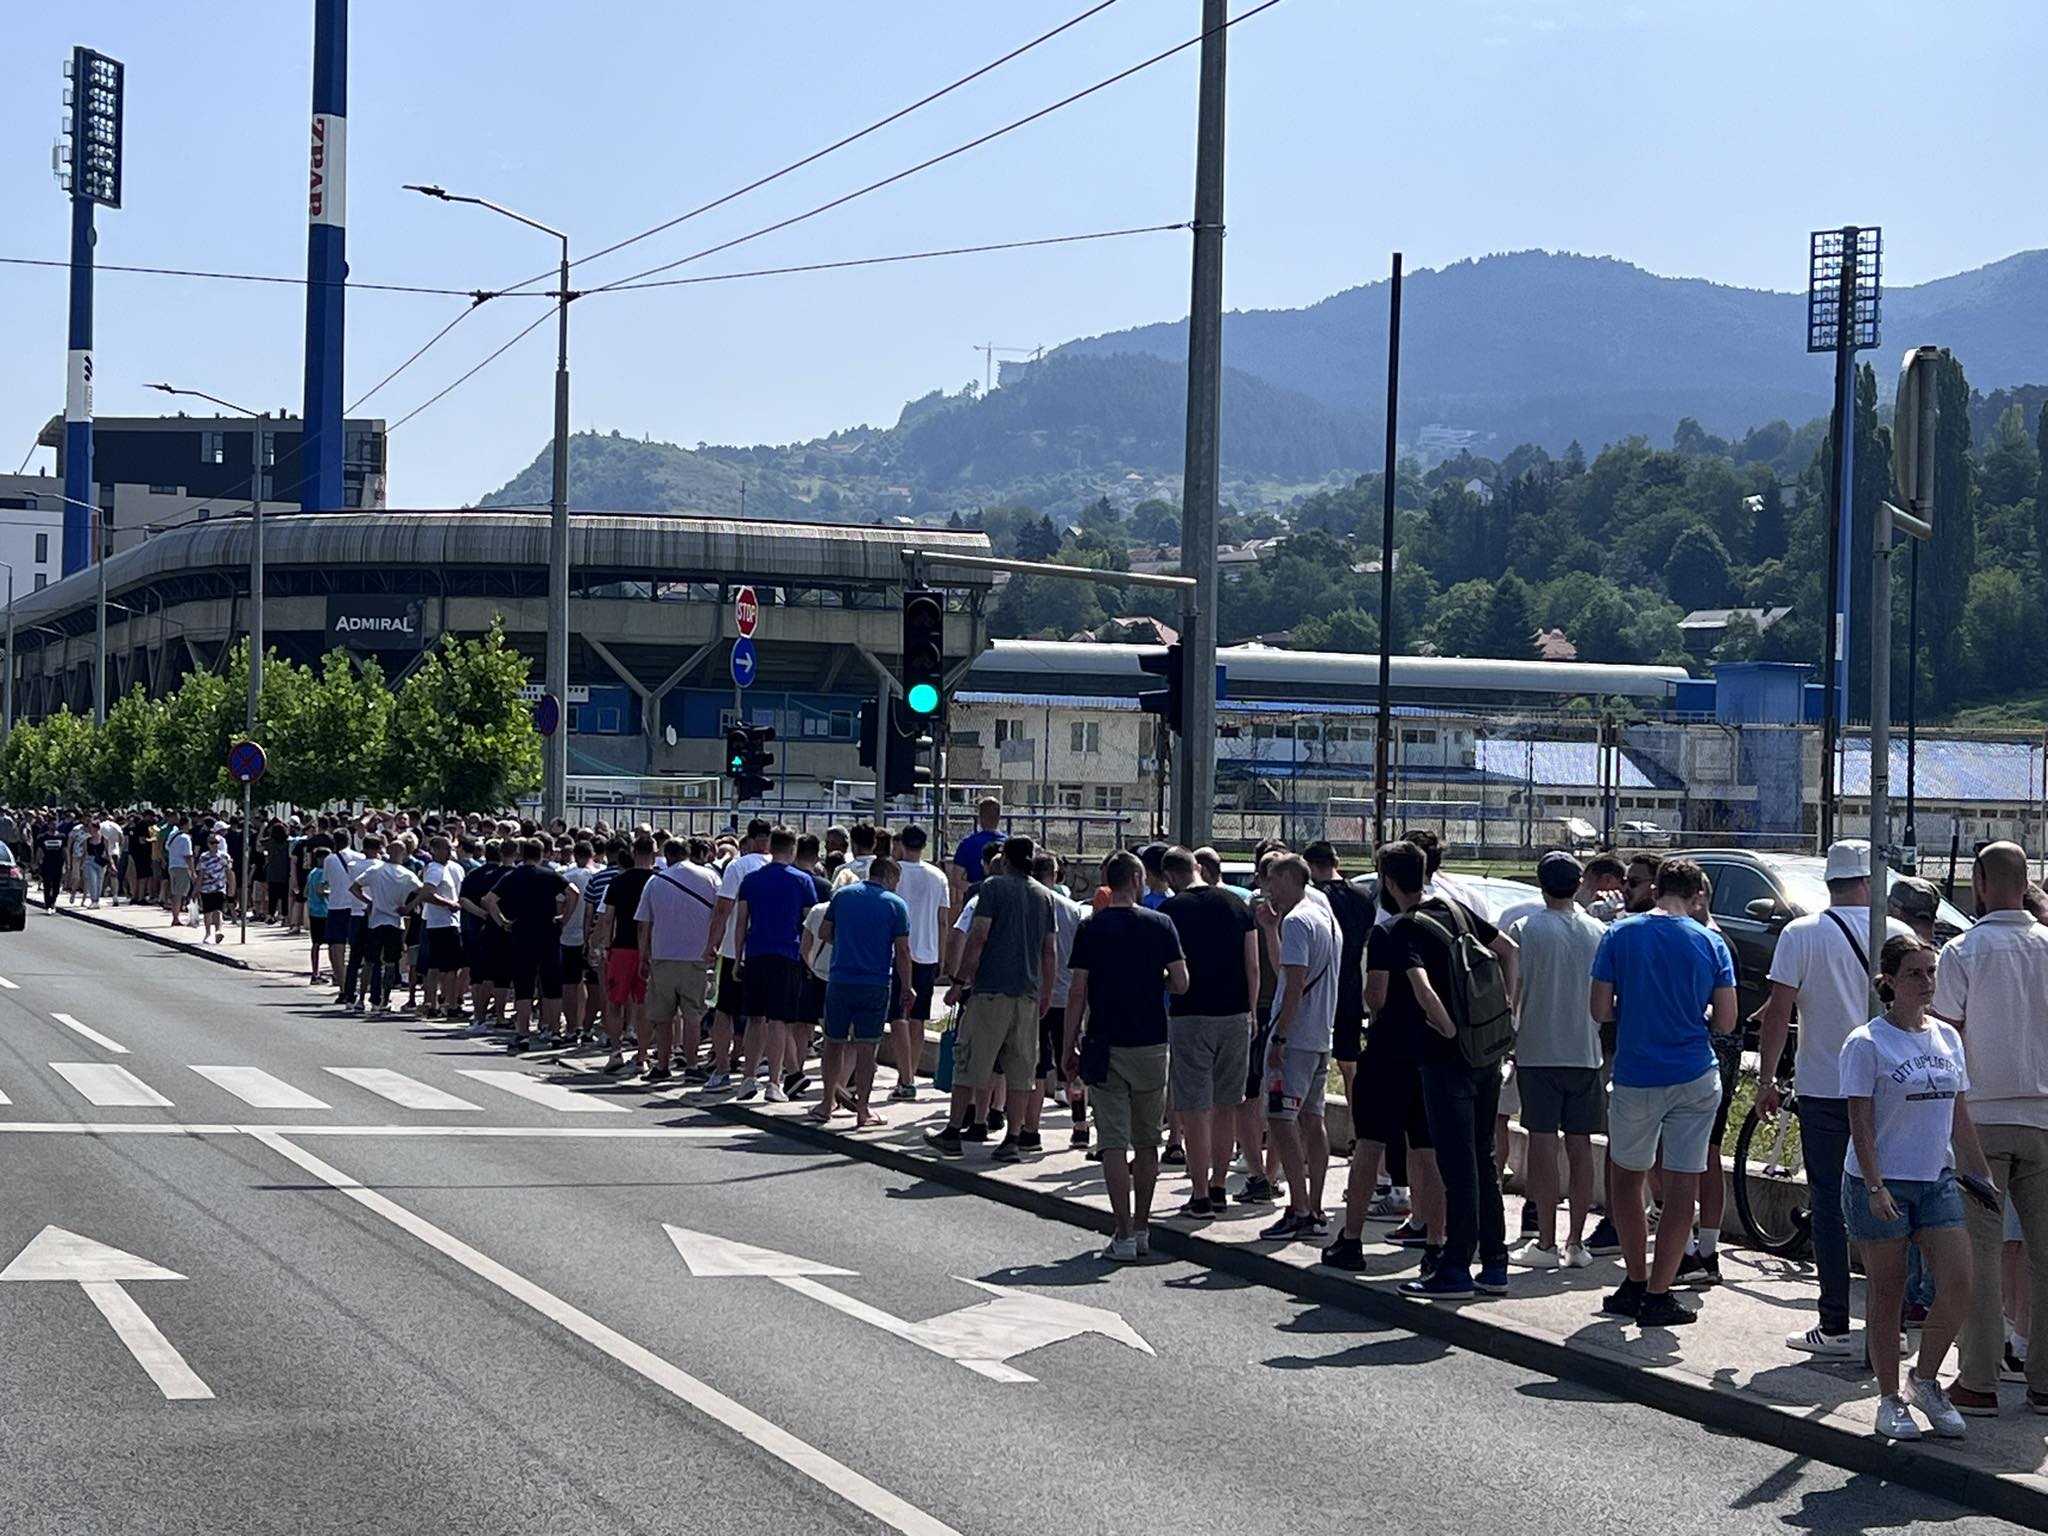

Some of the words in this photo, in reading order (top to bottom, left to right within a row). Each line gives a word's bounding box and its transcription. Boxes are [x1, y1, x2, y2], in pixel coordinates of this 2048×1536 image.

[738, 602, 756, 623] STOP
[335, 615, 414, 632] ADMIRAL
[1891, 1059, 1914, 1084] CITY
